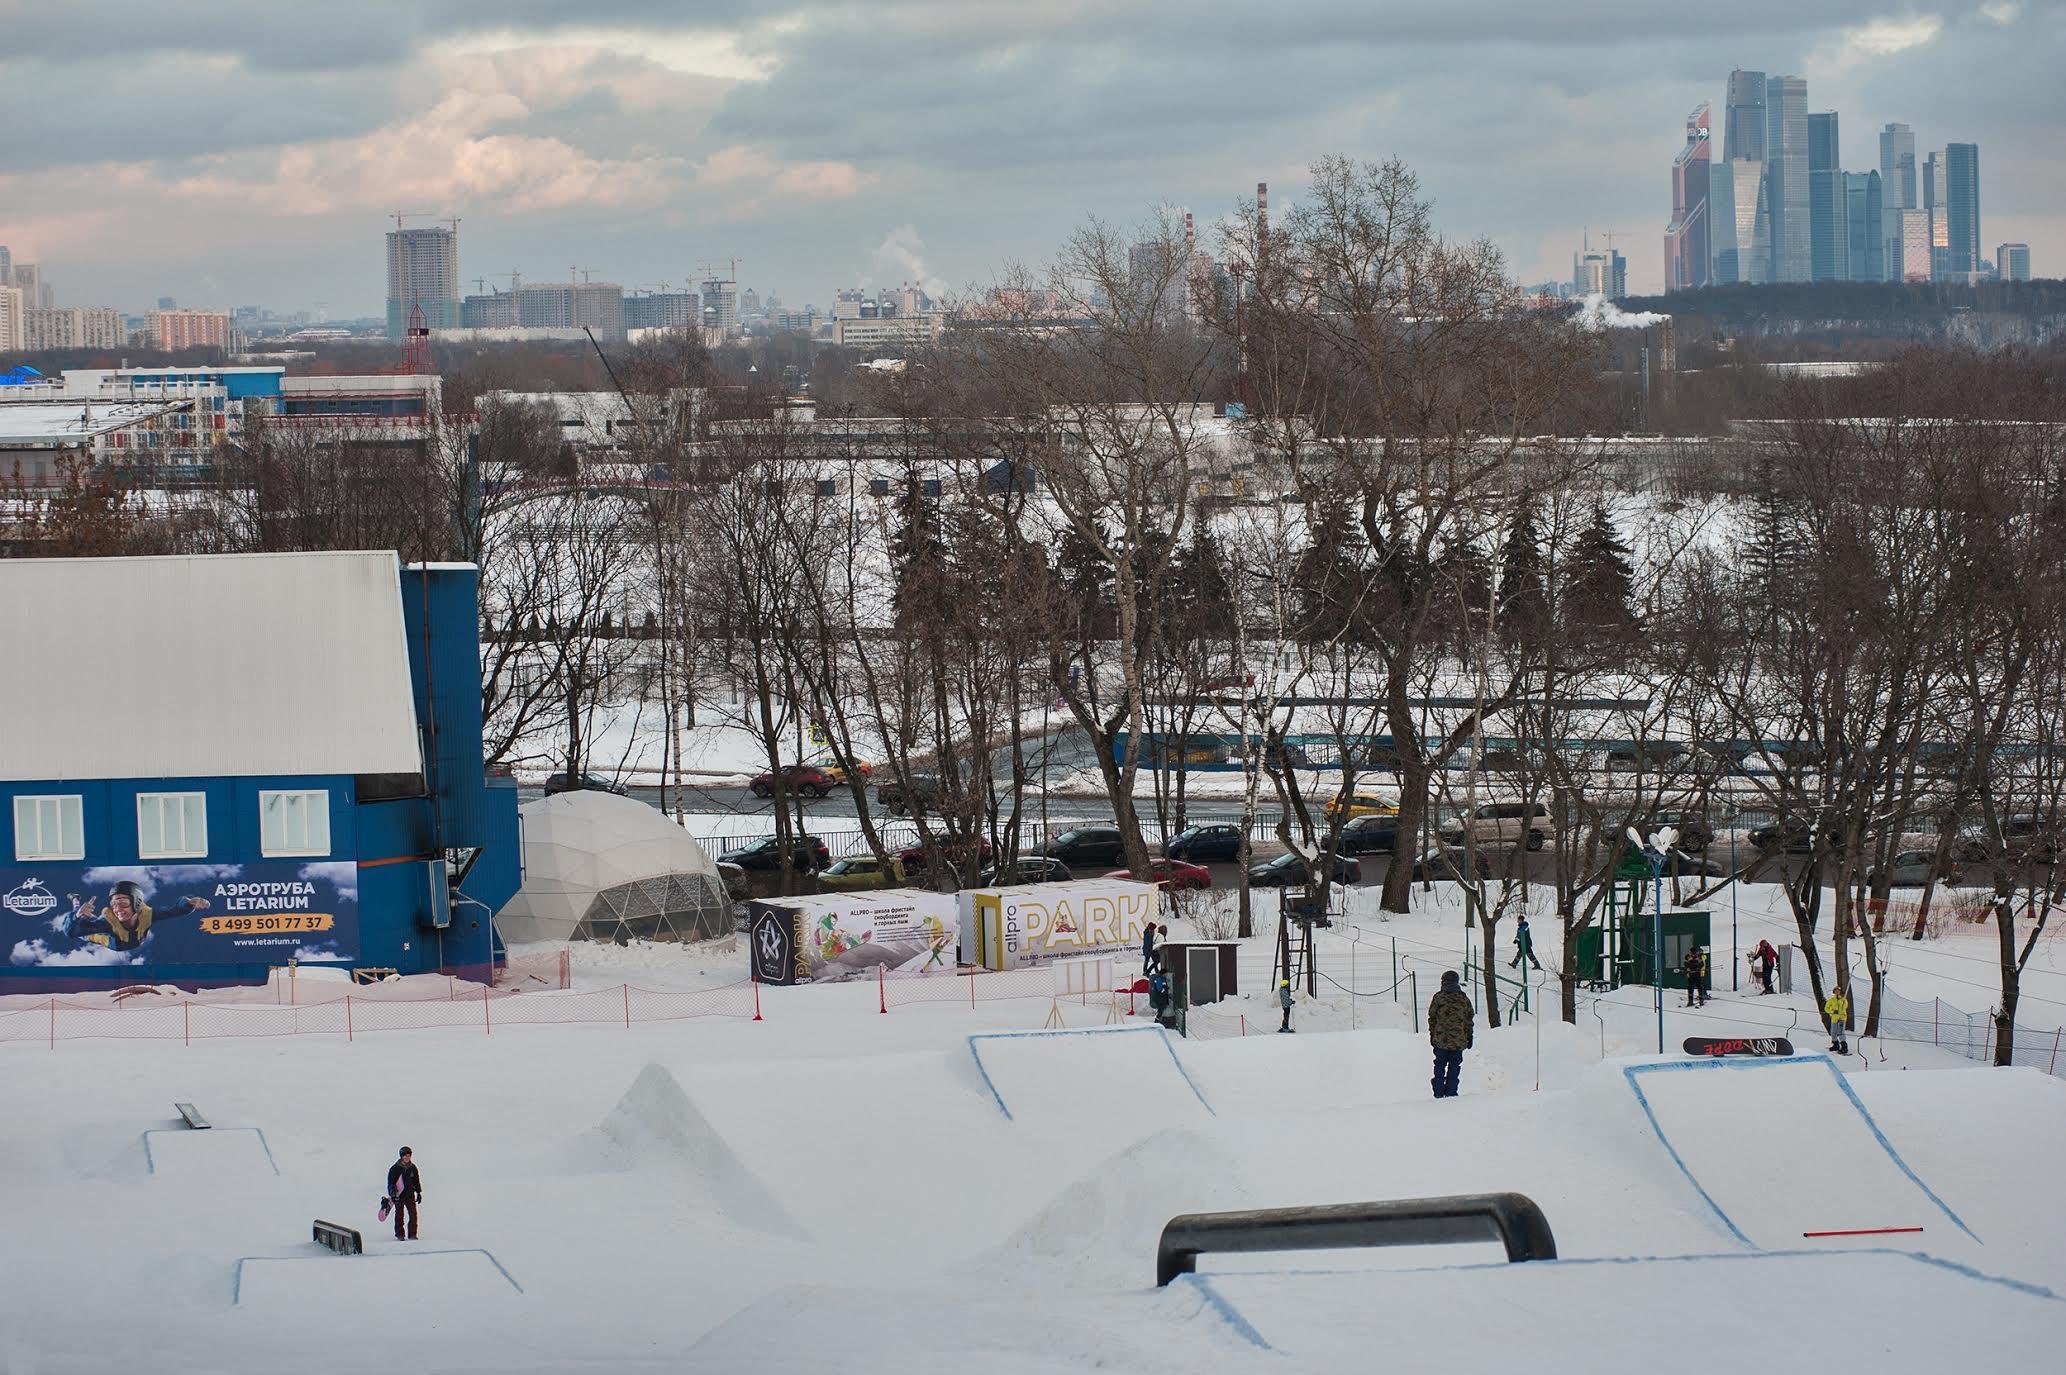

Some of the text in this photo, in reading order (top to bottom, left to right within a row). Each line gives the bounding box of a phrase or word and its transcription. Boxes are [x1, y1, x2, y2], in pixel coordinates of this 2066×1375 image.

[214, 882, 315, 896] АЭРОТРУБА
[4, 894, 57, 908] Letarium
[226, 896, 309, 910] LETARIUM
[212, 917, 322, 930] 8 499 501 77 37
[1005, 905, 1020, 953] allpro
[1019, 894, 1149, 951] PARK
[233, 937, 301, 946] www.letarium.ru
